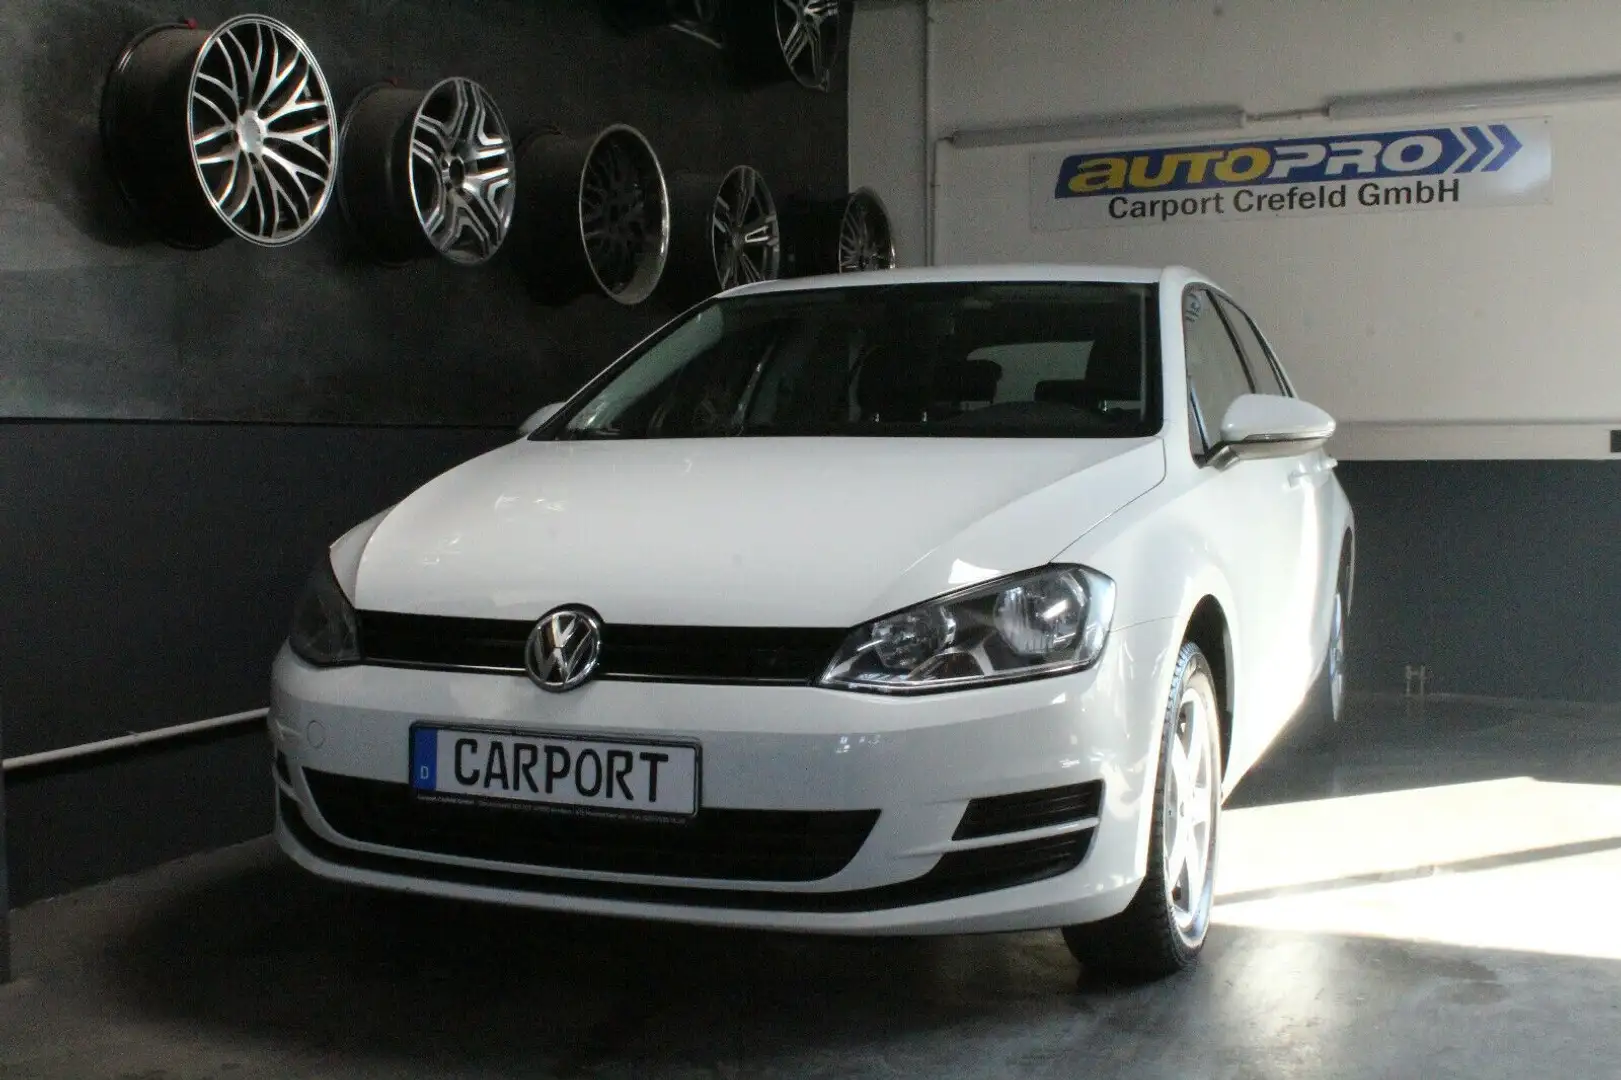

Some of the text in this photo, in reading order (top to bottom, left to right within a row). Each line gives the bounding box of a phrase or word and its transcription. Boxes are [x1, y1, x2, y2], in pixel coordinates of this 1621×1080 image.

[1108, 179, 1460, 221] Carport Crefeld GmbH
[419, 738, 668, 802] D CARPORT
